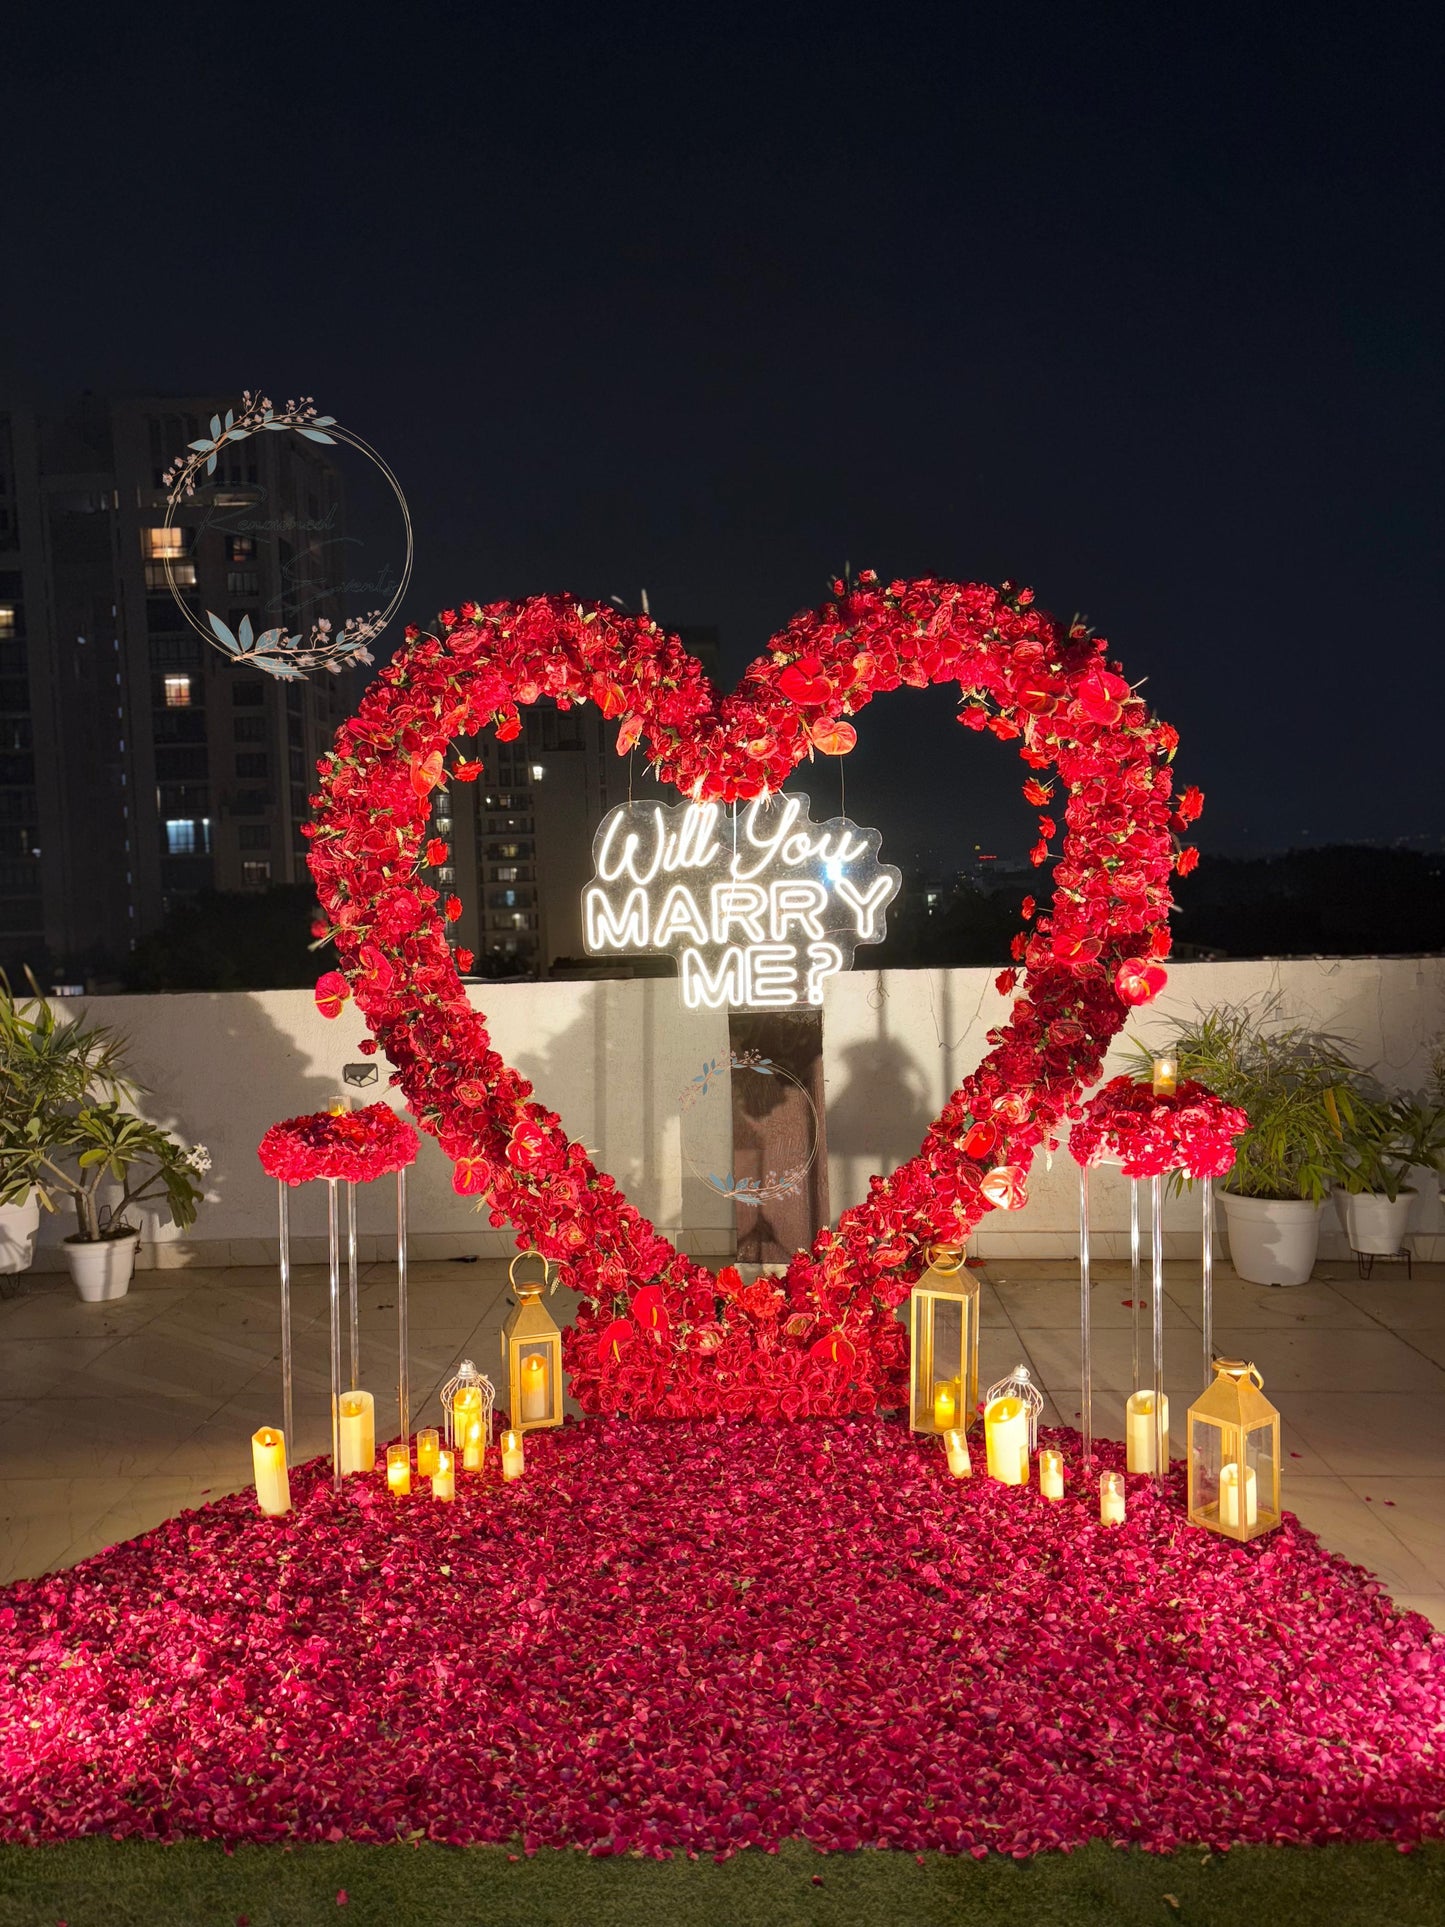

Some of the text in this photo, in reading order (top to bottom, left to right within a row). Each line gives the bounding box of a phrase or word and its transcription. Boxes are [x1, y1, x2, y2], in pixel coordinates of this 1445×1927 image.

[599, 798, 868, 884] Will You
[586, 875, 893, 949] MARRY
[682, 942, 843, 1008] ME?
